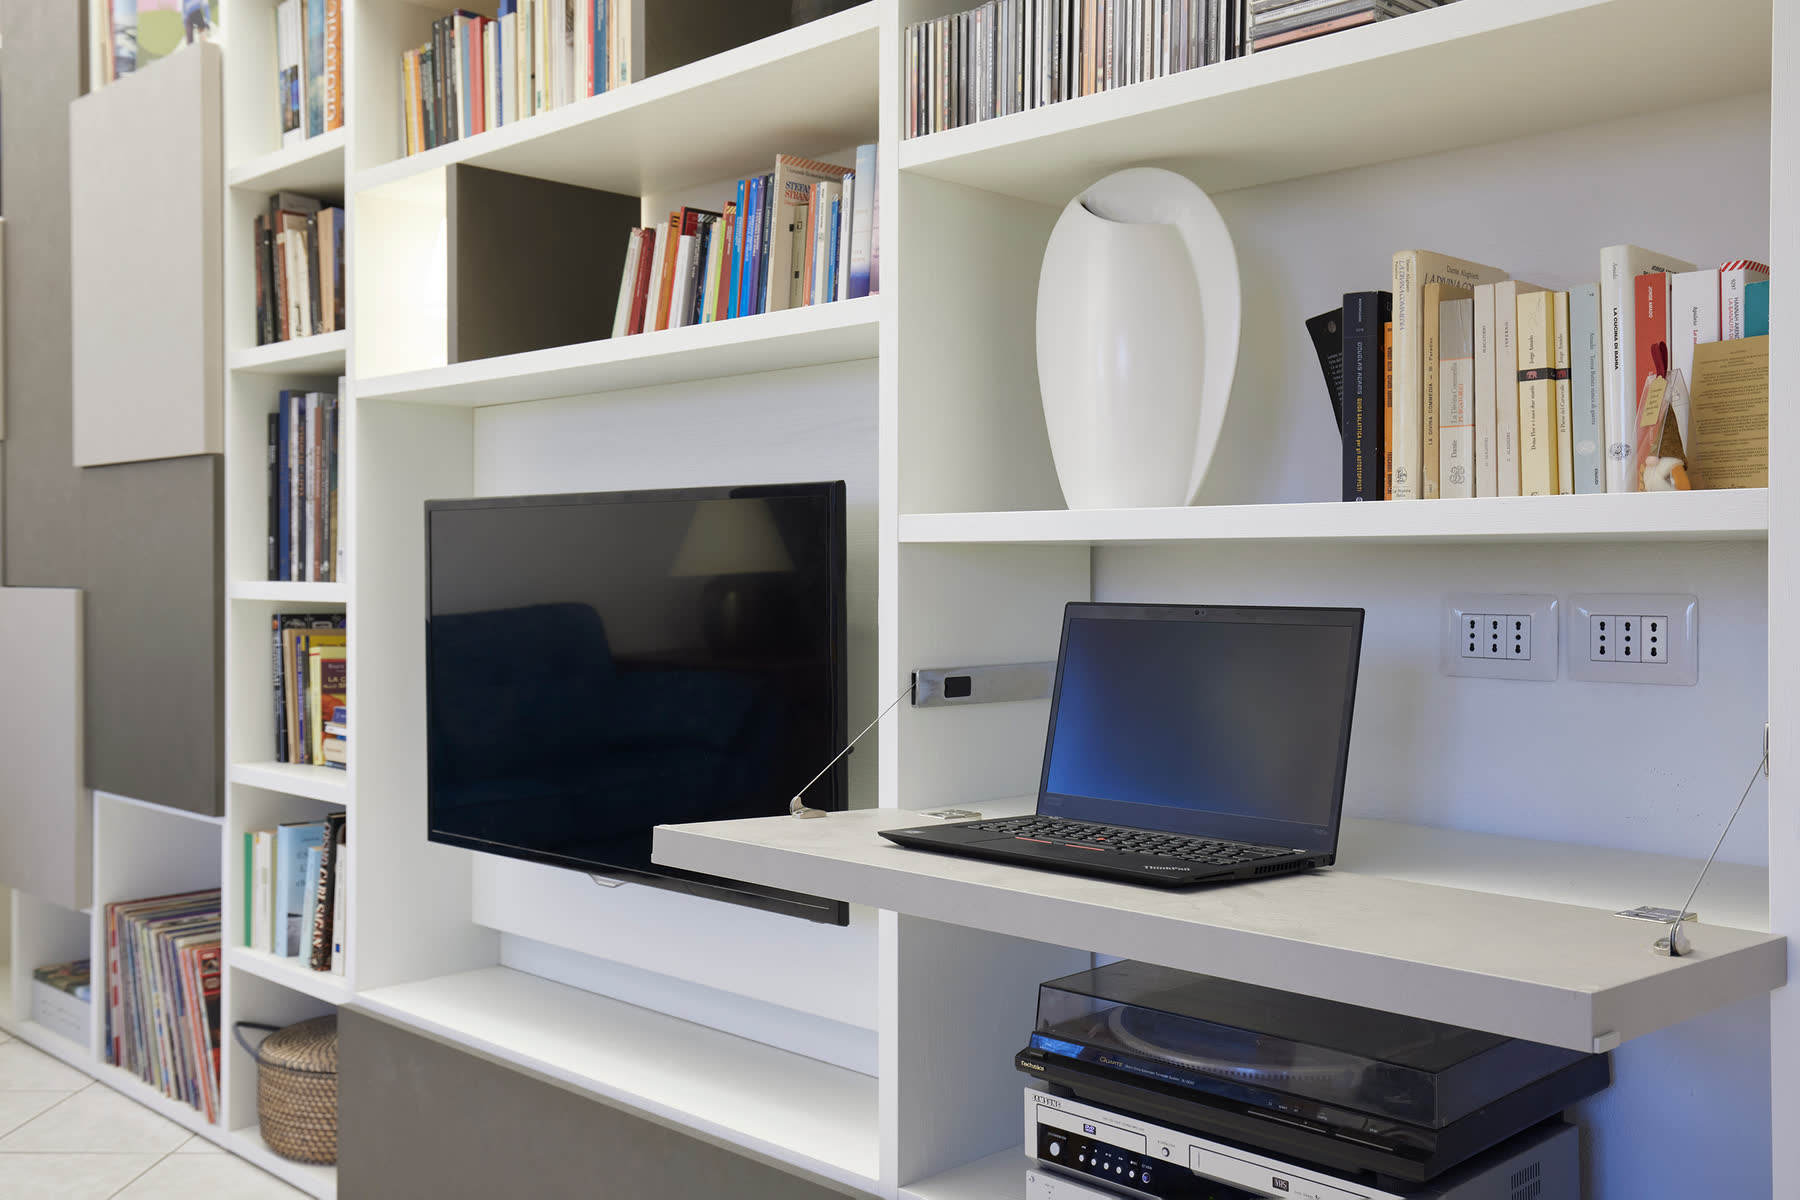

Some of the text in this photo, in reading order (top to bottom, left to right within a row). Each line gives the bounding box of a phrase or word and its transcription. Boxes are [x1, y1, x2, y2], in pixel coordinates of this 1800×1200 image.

[1613, 307, 1619, 316] LA
[1450, 439, 1458, 458] Dante
[317, 868, 329, 901] CARL
[312, 903, 326, 948] SAGAN
[1021, 1060, 1045, 1071] Technics
[1032, 1095, 1061, 1108] SAMSUNG
[1274, 1180, 1288, 1190] VHS
